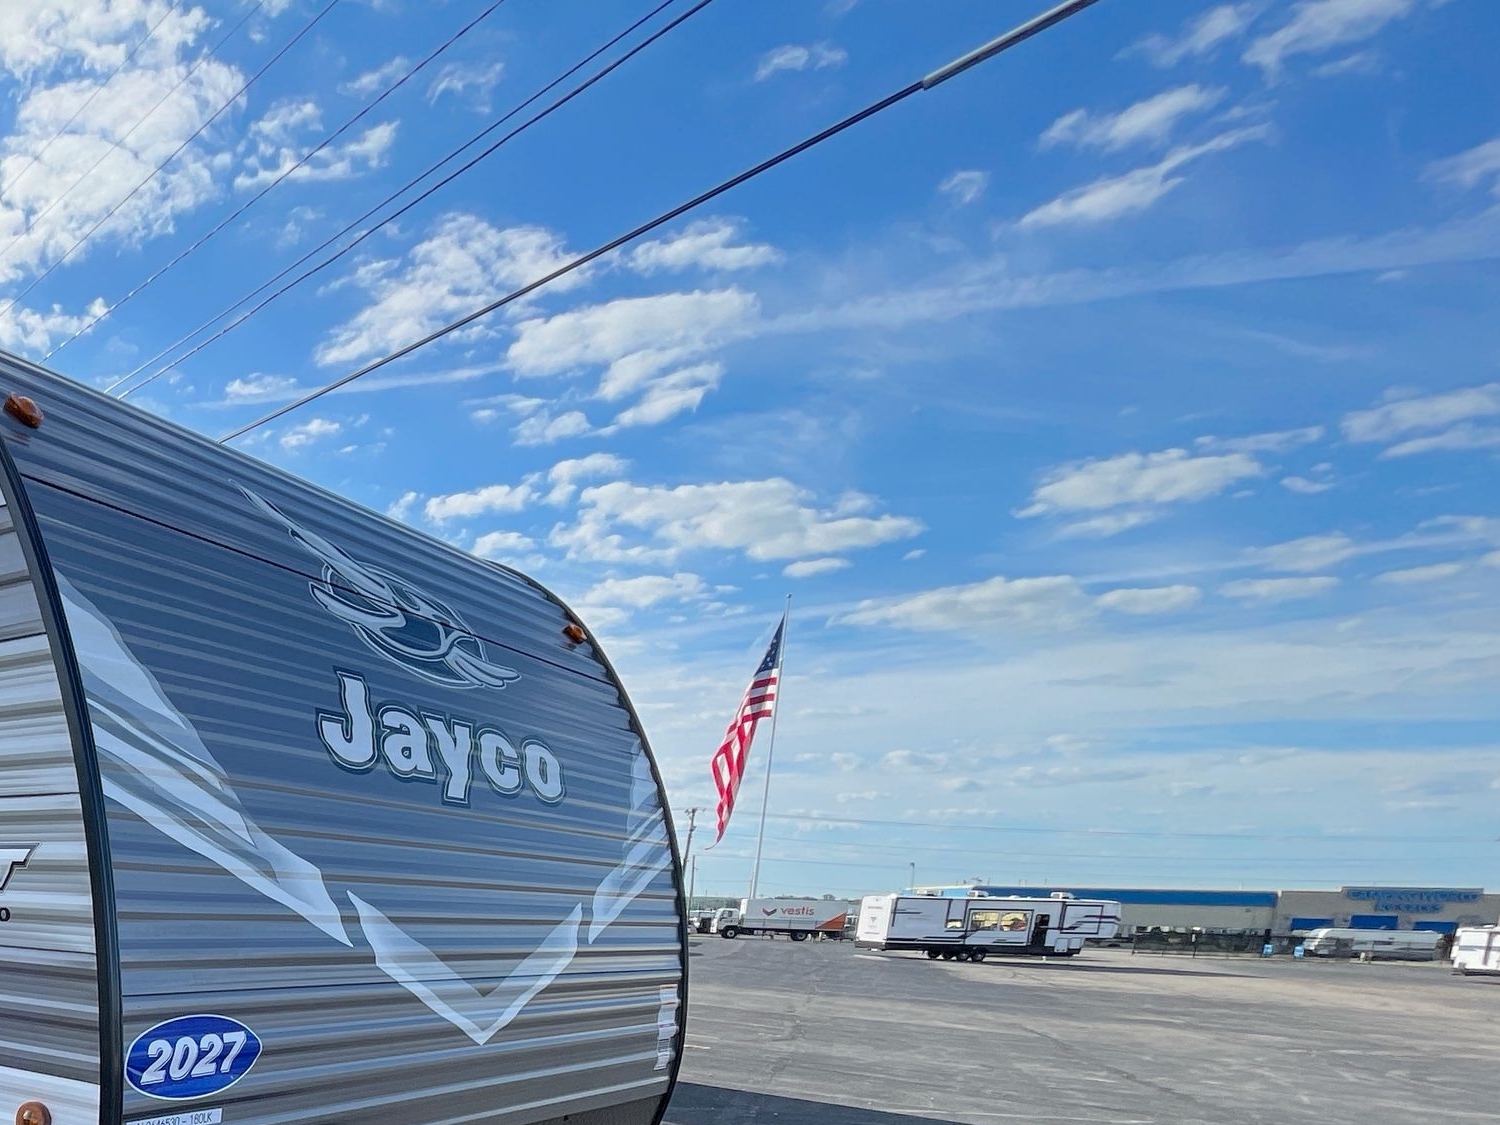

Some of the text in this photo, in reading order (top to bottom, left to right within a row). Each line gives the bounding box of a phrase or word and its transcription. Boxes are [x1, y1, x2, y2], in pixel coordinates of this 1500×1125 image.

[318, 669, 565, 805] Jayco
[781, 906, 815, 916] vestis
[140, 1030, 247, 1086] 2027
